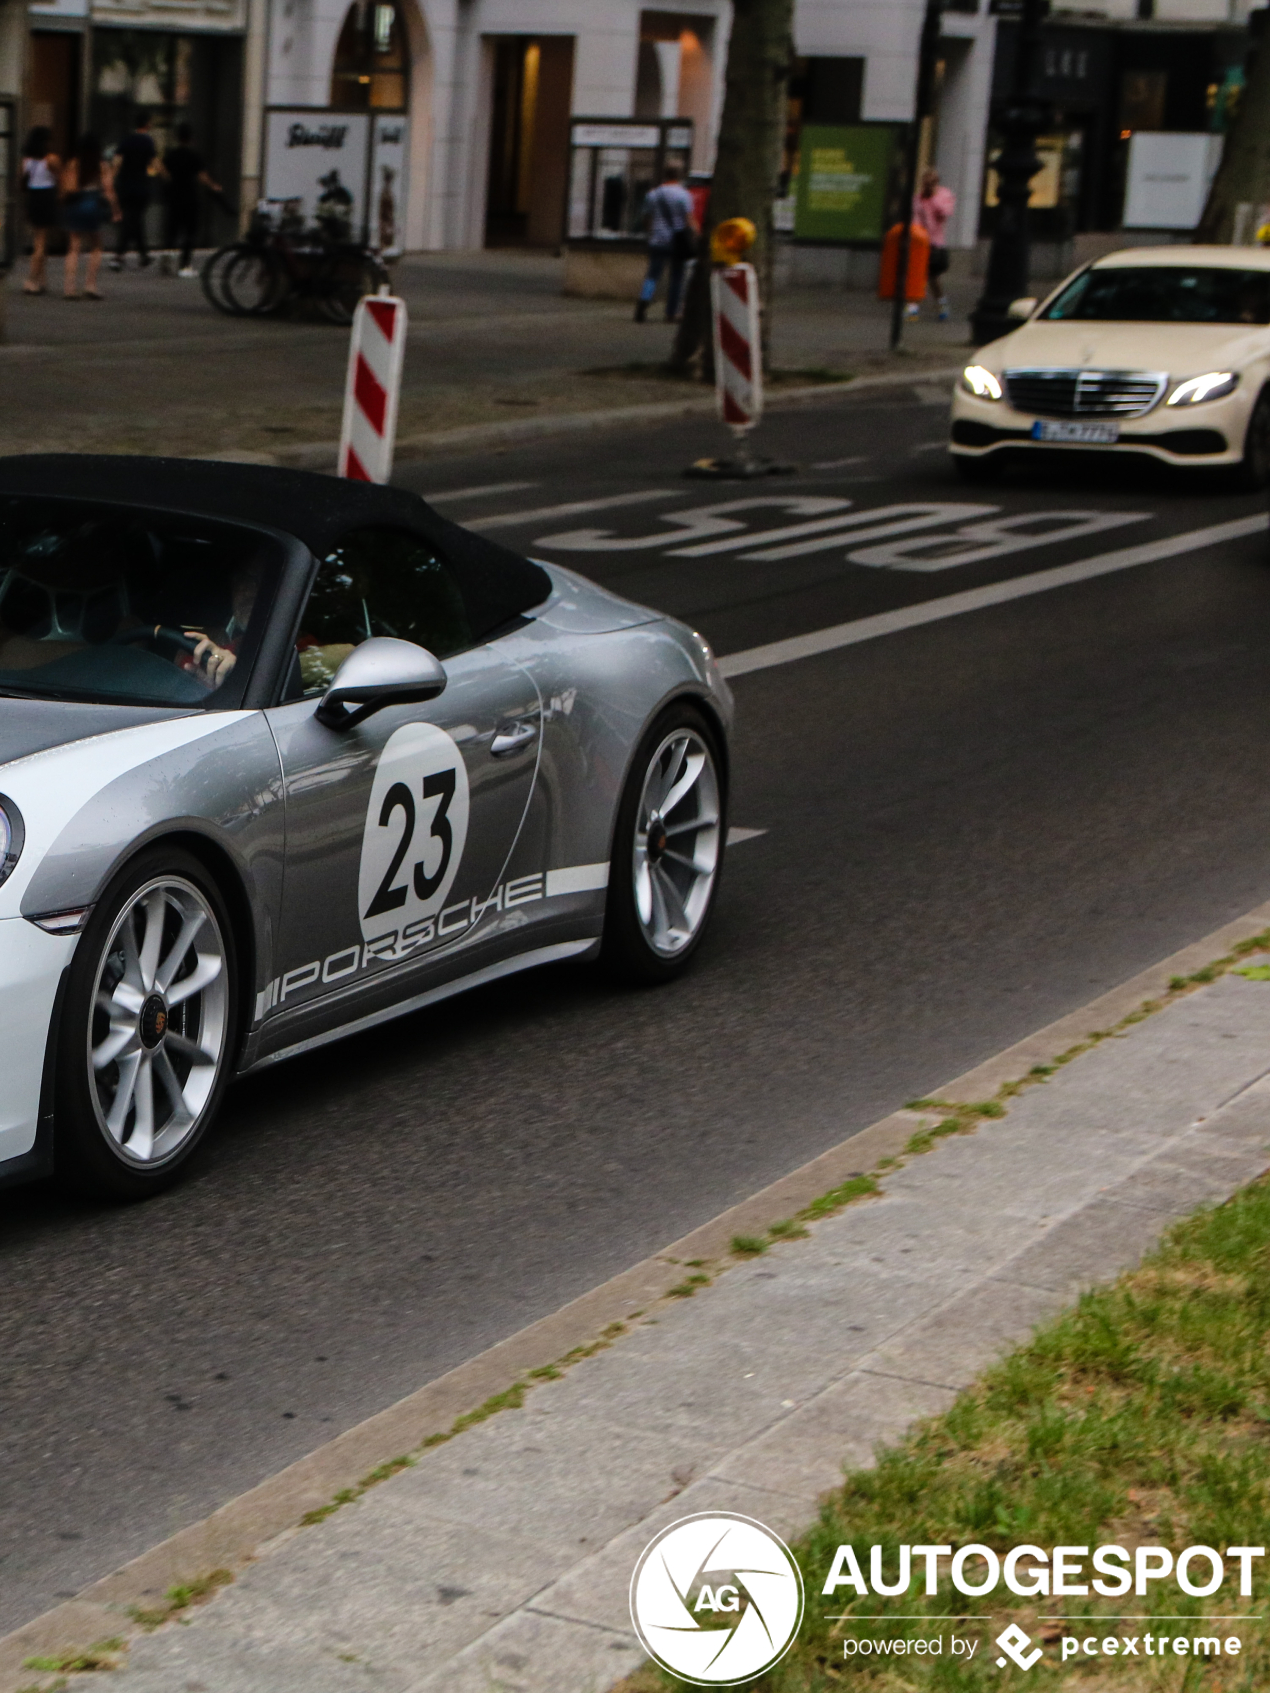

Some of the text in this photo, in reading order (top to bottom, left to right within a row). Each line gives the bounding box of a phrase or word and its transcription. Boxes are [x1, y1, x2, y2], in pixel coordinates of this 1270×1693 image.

[533, 496, 1155, 572] BUS
[363, 767, 456, 919] 23
[280, 873, 543, 1001] PORSCHE
